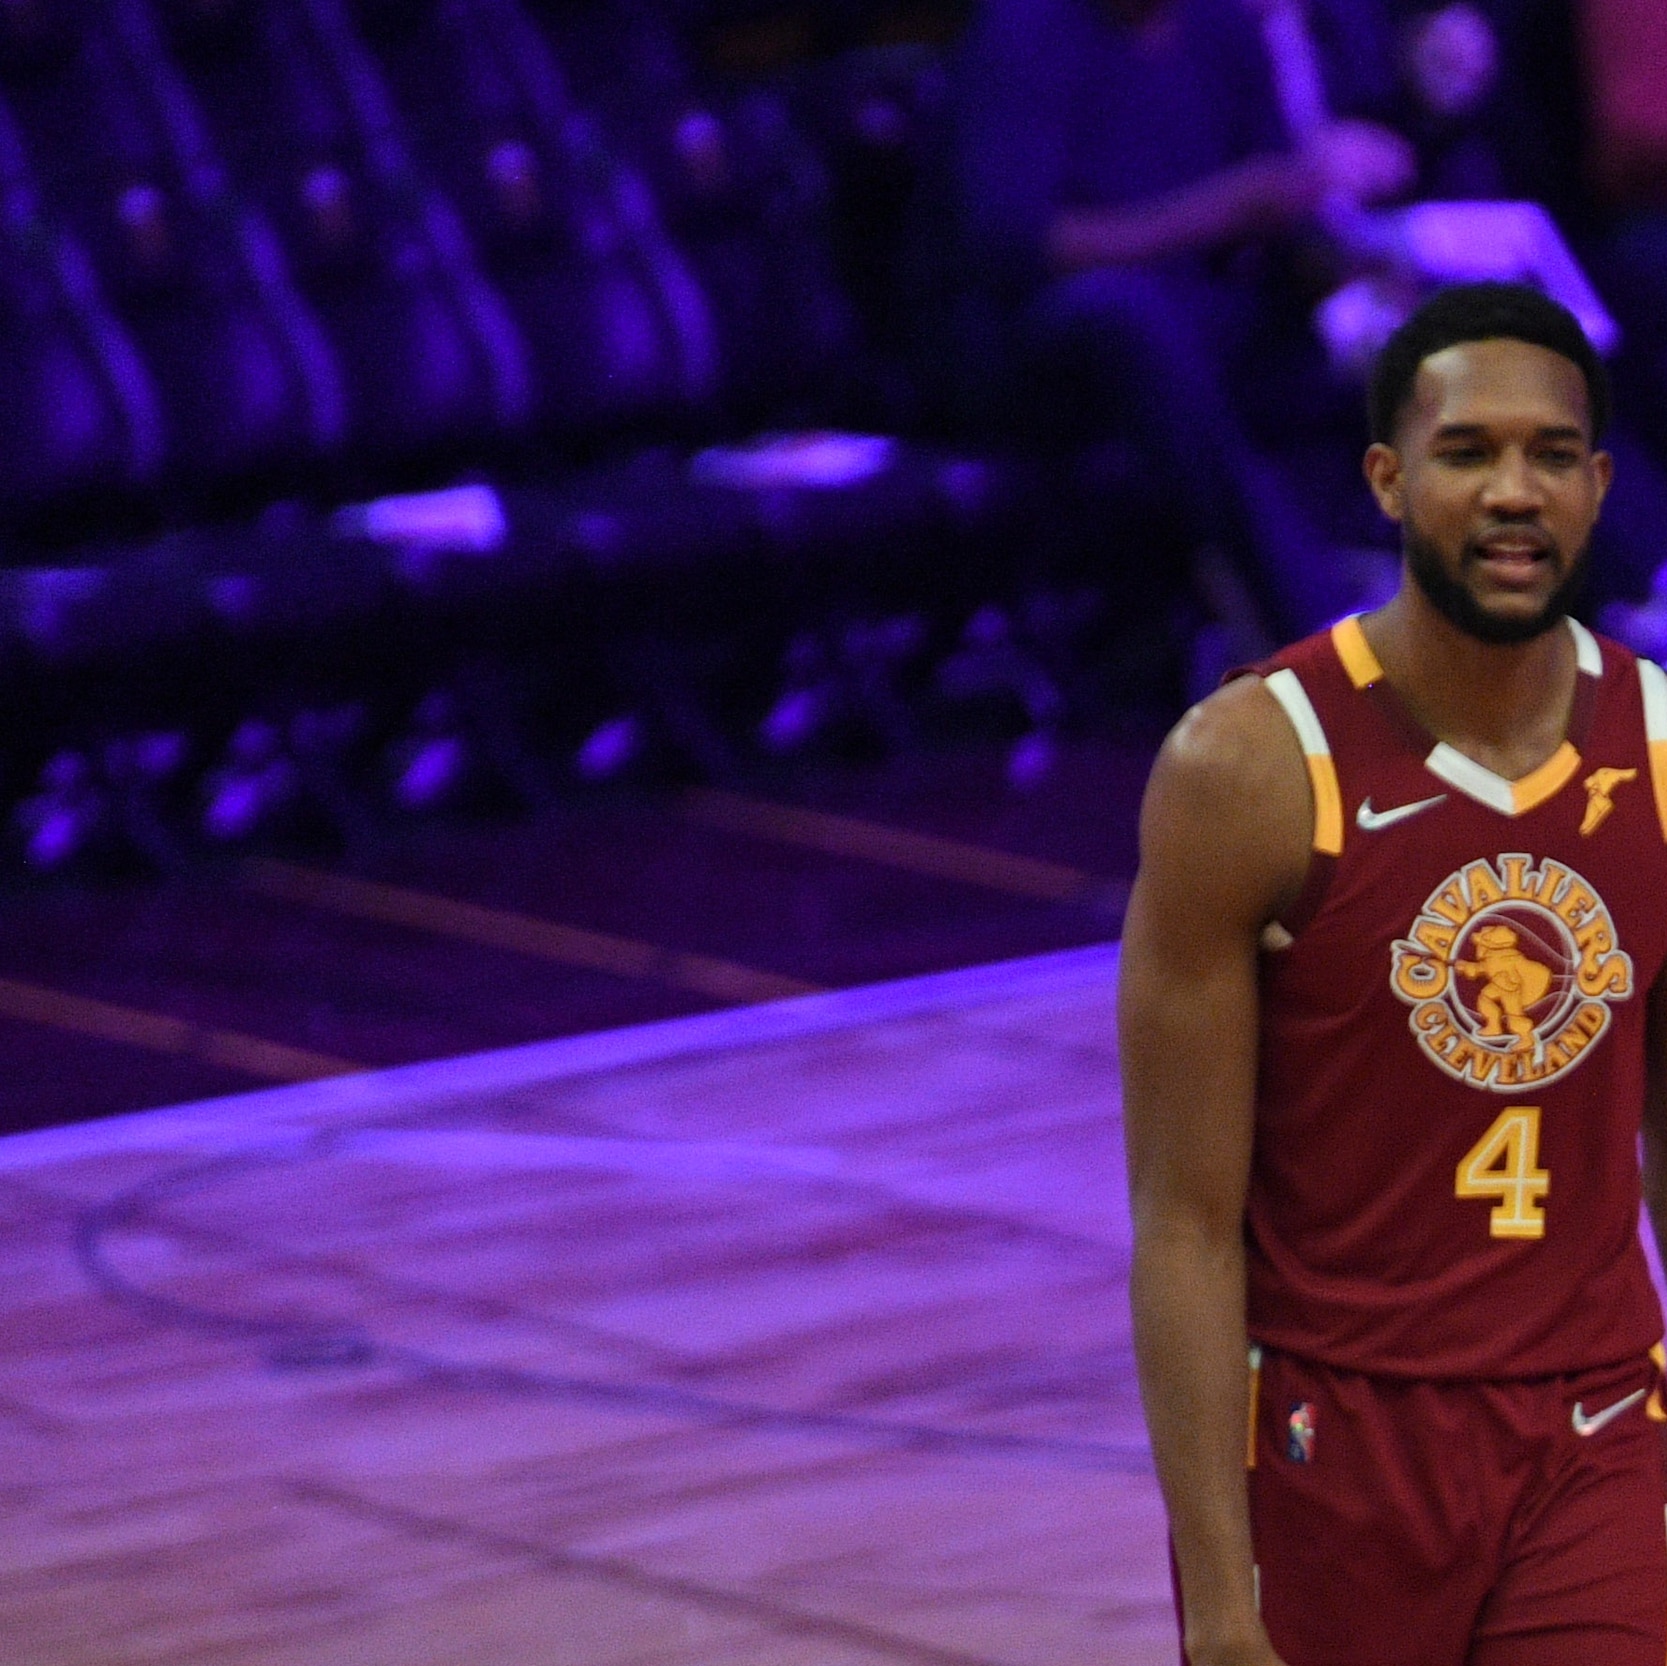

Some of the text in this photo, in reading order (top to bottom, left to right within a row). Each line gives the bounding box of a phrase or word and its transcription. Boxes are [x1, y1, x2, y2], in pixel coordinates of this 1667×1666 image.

[1390, 852, 1634, 1002] CAVALIERS
[1409, 1000, 1612, 1094] CLEVELAND
[1454, 1106, 1551, 1241] 4
